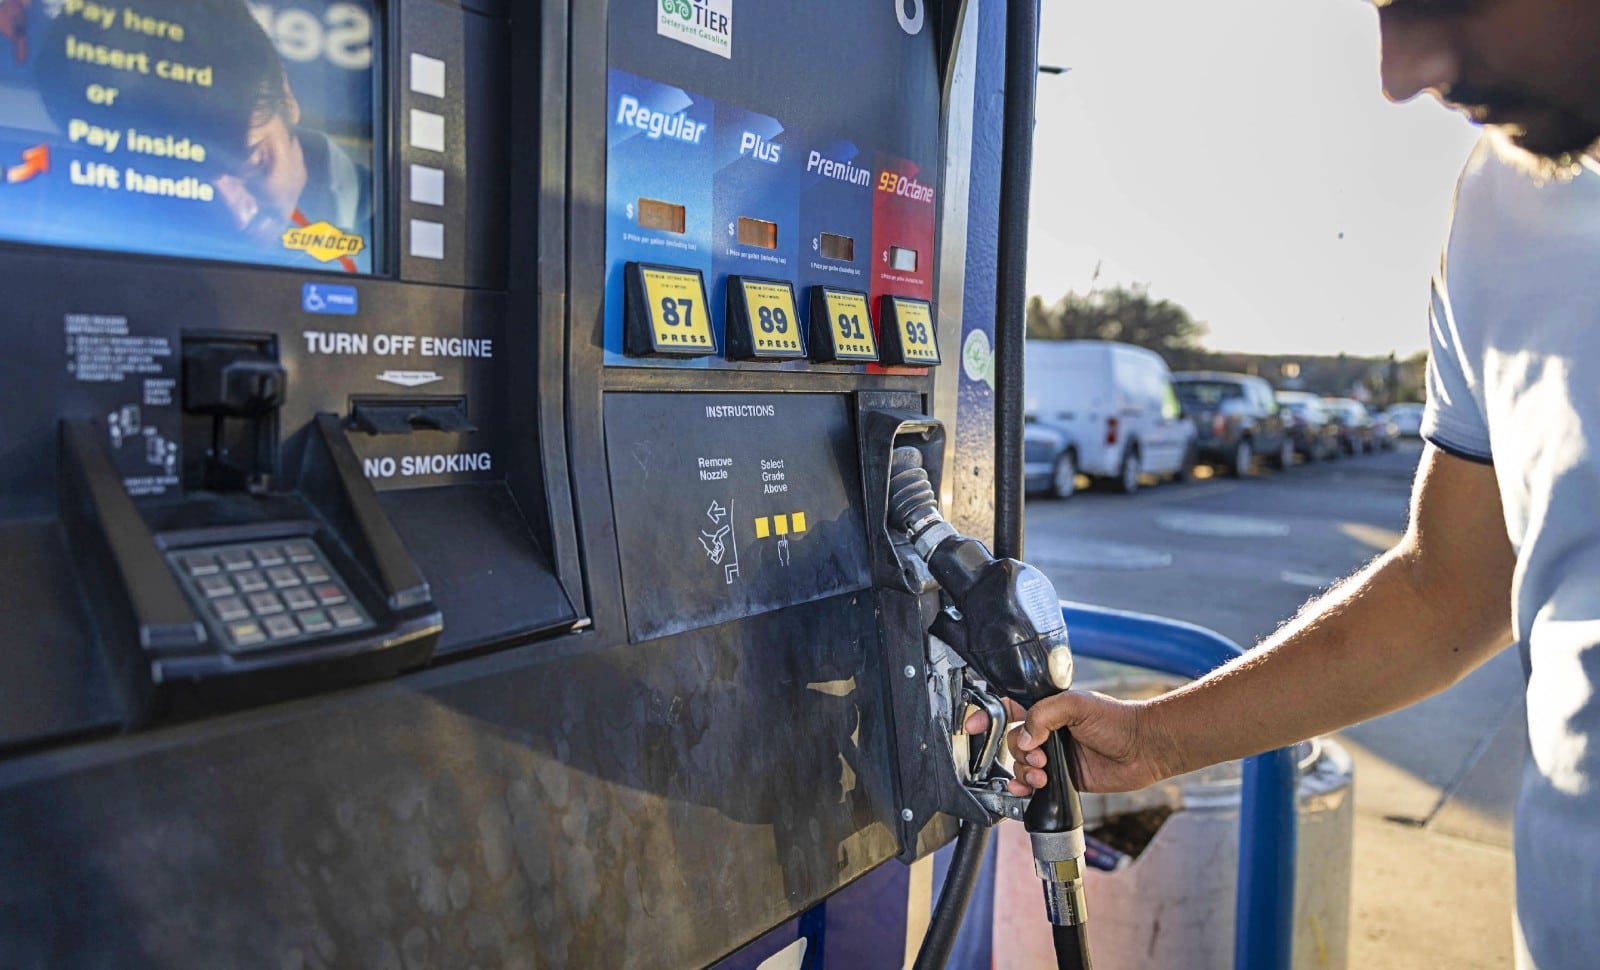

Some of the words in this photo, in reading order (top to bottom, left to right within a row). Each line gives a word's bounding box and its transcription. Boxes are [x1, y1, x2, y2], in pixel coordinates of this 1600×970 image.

[64, 0, 116, 28] Pay
[123, 9, 184, 42] here
[693, 4, 728, 35] TIER
[661, 15, 698, 34] Detergent
[698, 29, 728, 47] Gasoline
[66, 36, 149, 74] Insert
[156, 59, 213, 87] card
[87, 84, 118, 105] or
[616, 95, 707, 144] Regular
[69, 119, 120, 153] Pay
[127, 129, 206, 163] inside
[740, 132, 783, 163] Plus
[807, 150, 871, 187] Premium
[70, 161, 120, 190] Lift
[126, 167, 214, 202] handle
[625, 203, 634, 219] $
[728, 221, 735, 237] $
[287, 231, 359, 253] SUNOCO
[812, 237, 819, 251] $
[882, 250, 888, 264] $
[661, 296, 693, 327] 87
[758, 305, 788, 334] 89
[838, 313, 864, 340] 91
[905, 321, 928, 345] 93
[303, 331, 368, 354] TURN
[373, 334, 416, 355] OFF
[420, 337, 493, 357] ENGINE
[661, 333, 706, 344] PRESS
[758, 338, 797, 349] PRESS
[839, 343, 871, 353] PRESS
[907, 348, 935, 358] PRESS
[705, 405, 775, 418] INSTRUCTIONS
[364, 457, 395, 478] NO
[400, 452, 491, 476] SMOKING
[698, 457, 733, 468] Remove
[760, 459, 785, 470] Select
[700, 469, 728, 481] Nozzle
[762, 471, 785, 481] Grade
[763, 482, 788, 494] Above
